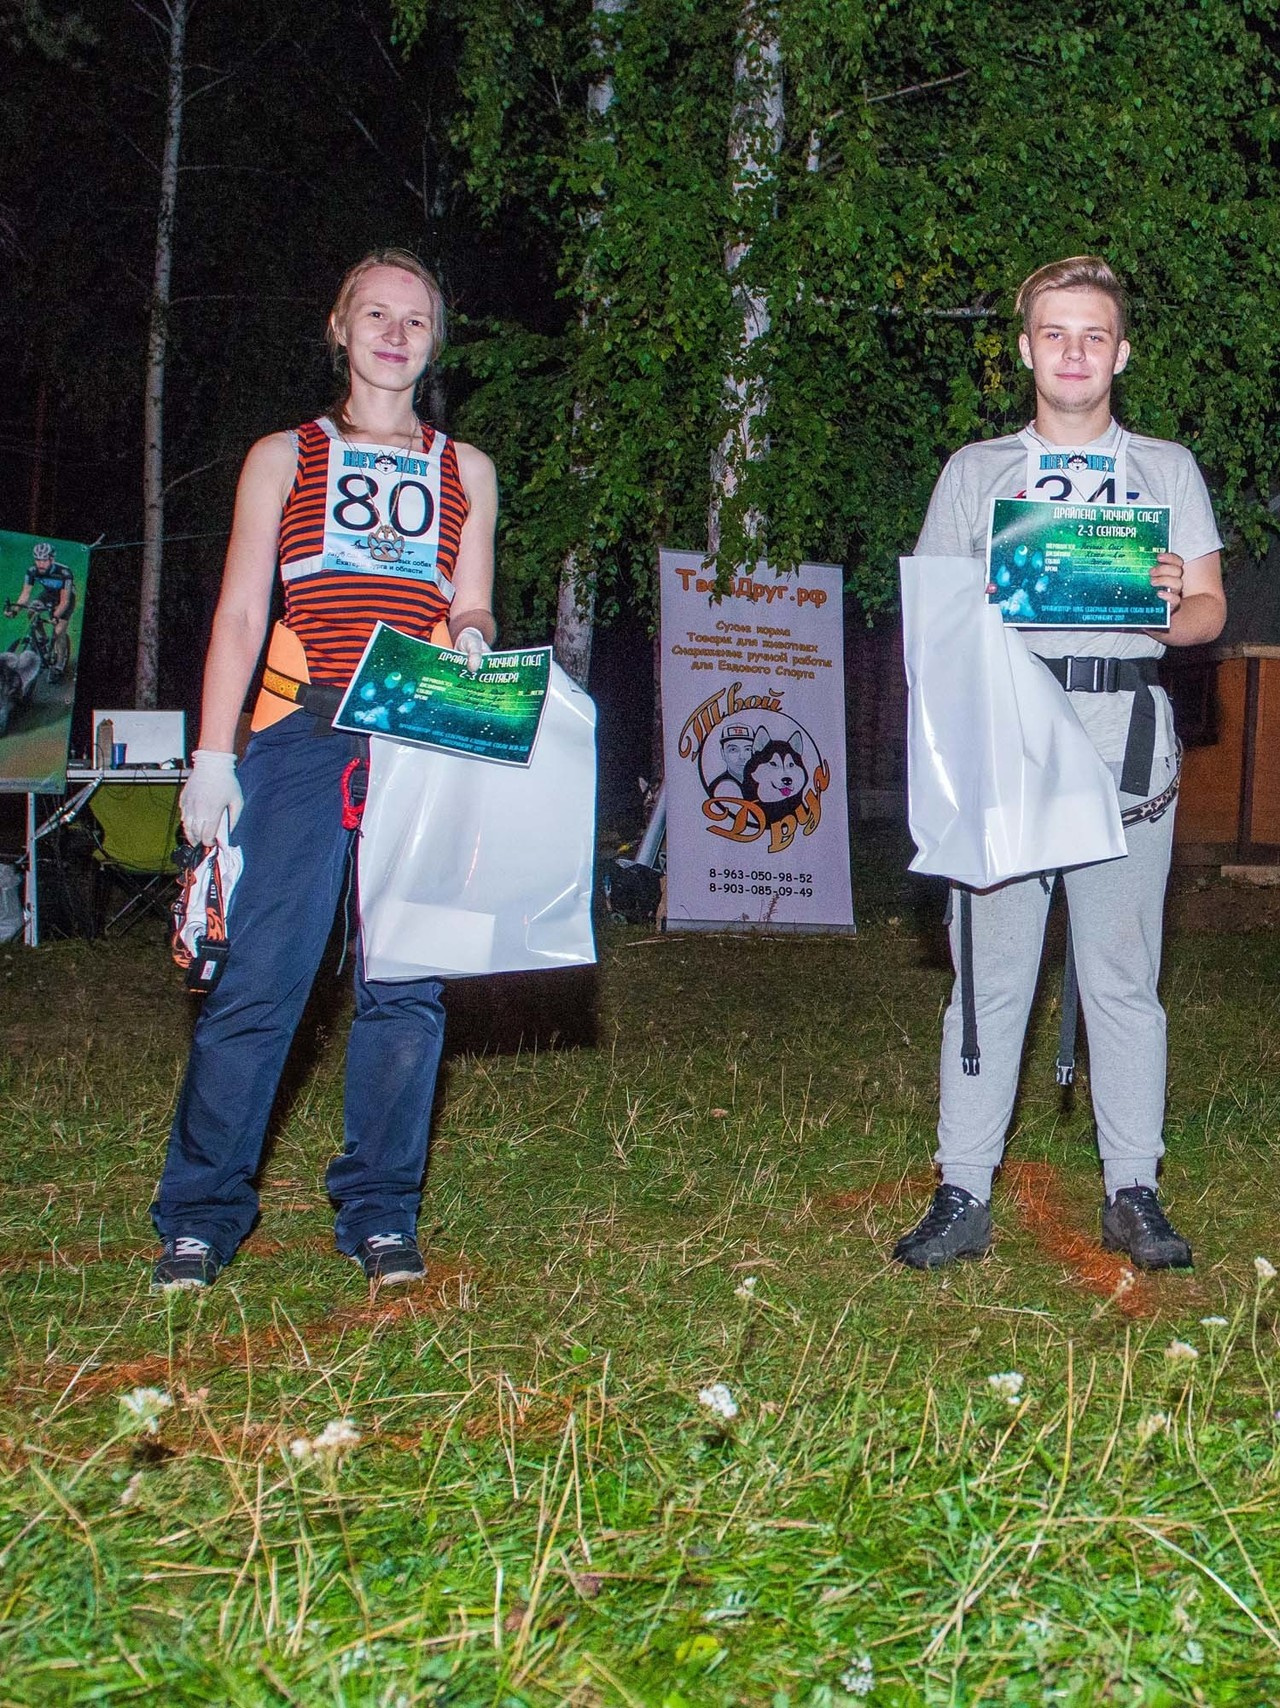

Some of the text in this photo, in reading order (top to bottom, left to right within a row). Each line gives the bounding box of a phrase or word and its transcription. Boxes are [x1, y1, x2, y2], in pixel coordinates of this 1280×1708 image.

[343, 451, 429, 476] HEY HEY
[1039, 454, 1117, 473] HEY HEY
[333, 474, 434, 537] 80
[1053, 507, 1097, 521] ДРАЙЛЕНД
[1078, 525, 1137, 538] 2-3 СЕНТЯБРЯ
[460, 669, 519, 684] 2-3 СЕНТЯБРЯ
[775, 666, 815, 680] Спорта
[678, 681, 785, 762] Твой
[709, 868, 812, 883] 8-963-050-98-52
[709, 883, 813, 897] 8-903-085-09-49
